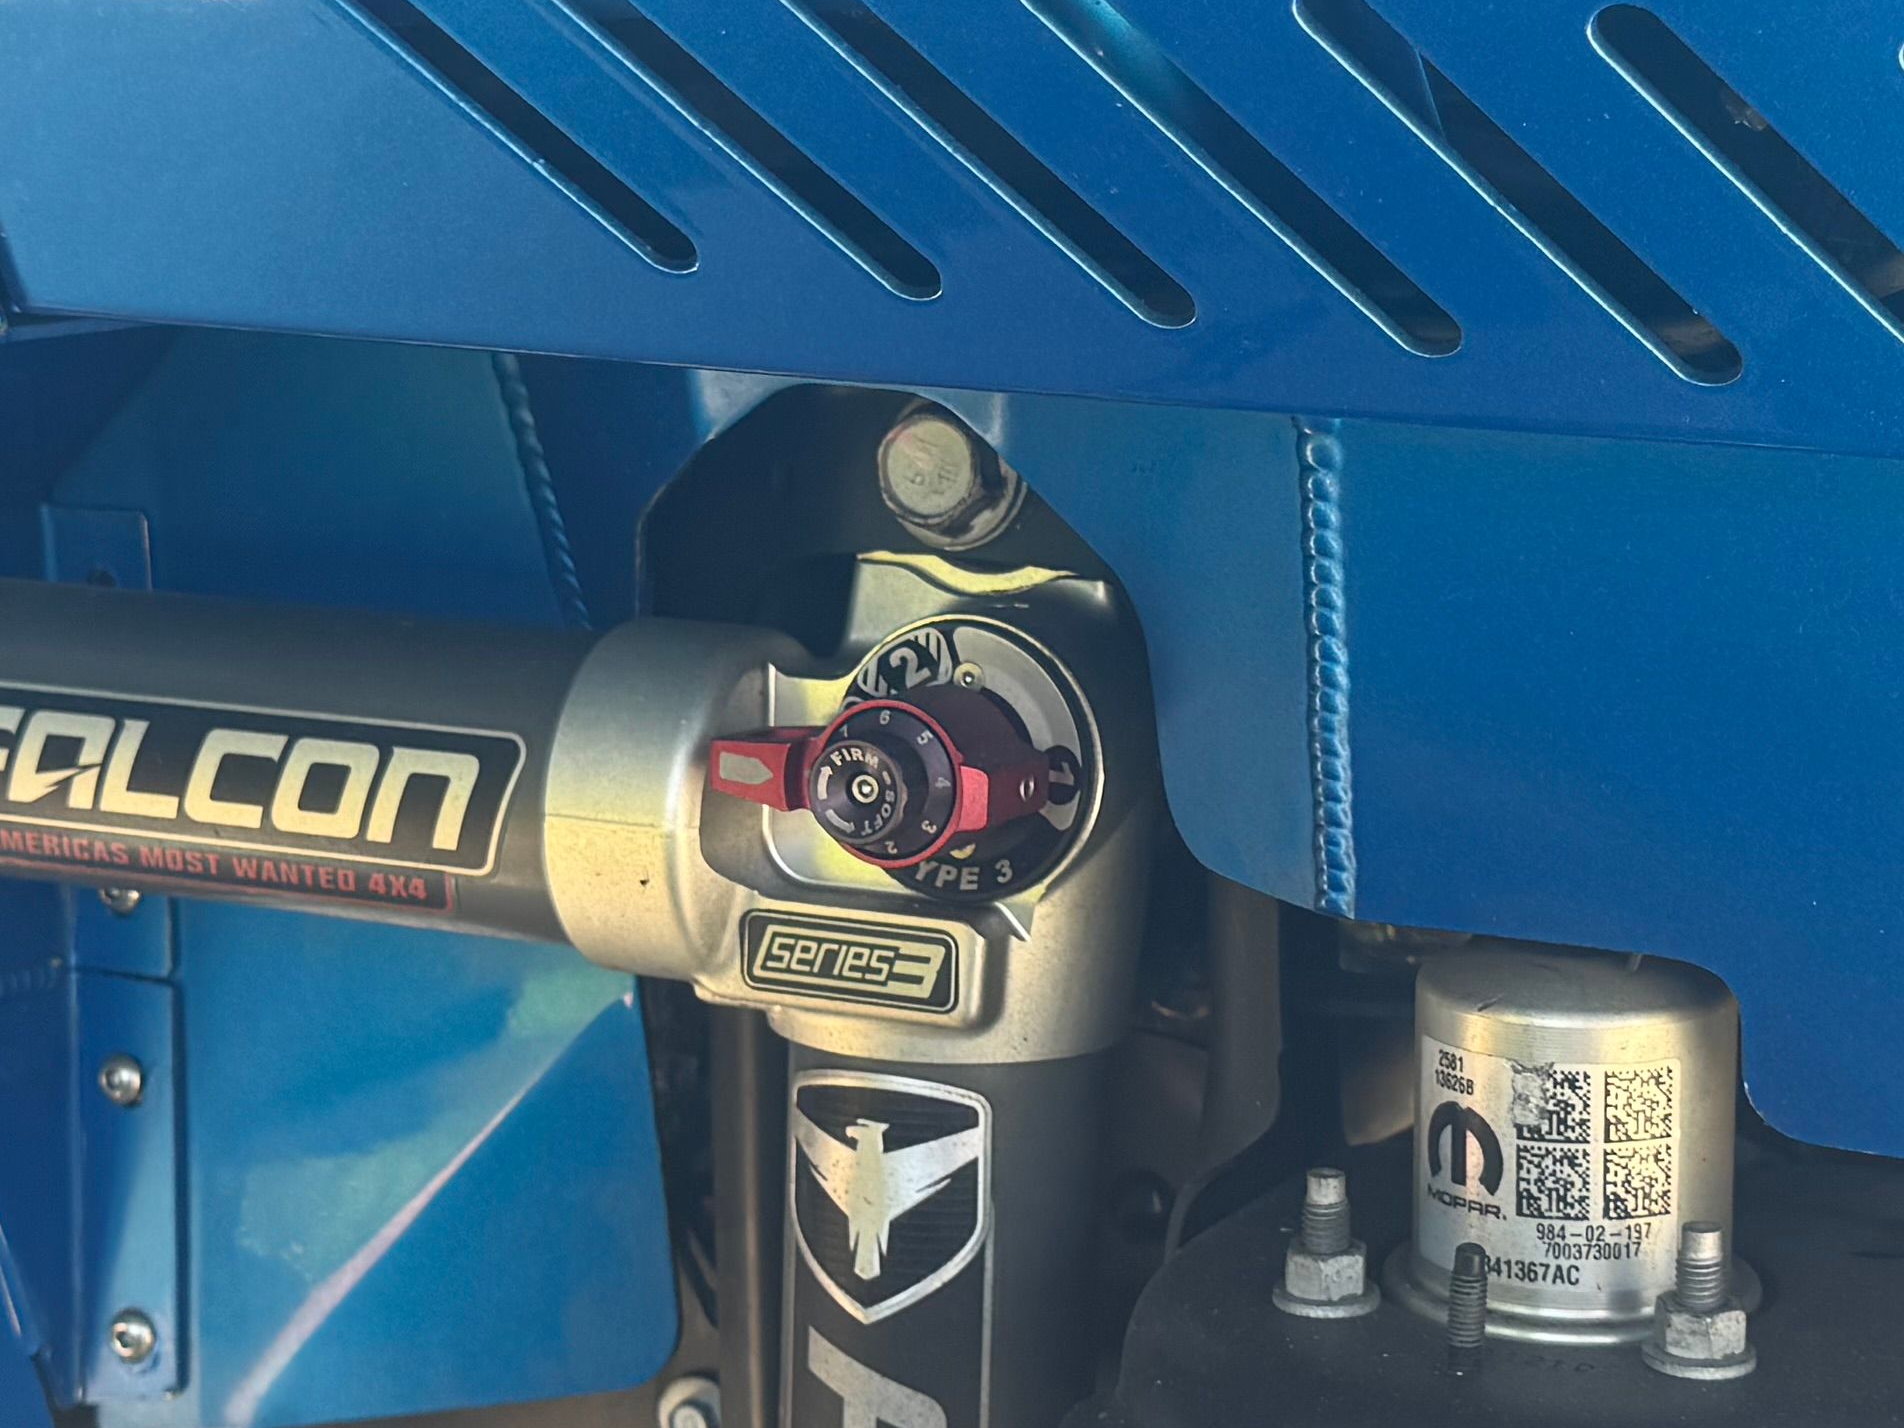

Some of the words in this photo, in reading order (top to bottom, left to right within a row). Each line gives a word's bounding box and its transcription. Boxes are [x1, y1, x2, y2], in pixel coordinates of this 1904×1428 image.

[879, 709, 892, 725] 6
[916, 729, 934, 745] 5
[829, 747, 880, 770] FIRM
[859, 789, 896, 837] SOFT
[921, 819, 938, 835] 3
[140, 846, 221, 878] MOST
[232, 857, 359, 894] WANTED
[367, 870, 429, 901] 4X4
[994, 858, 1014, 884] 3
[1438, 1049, 1465, 1073] 2581
